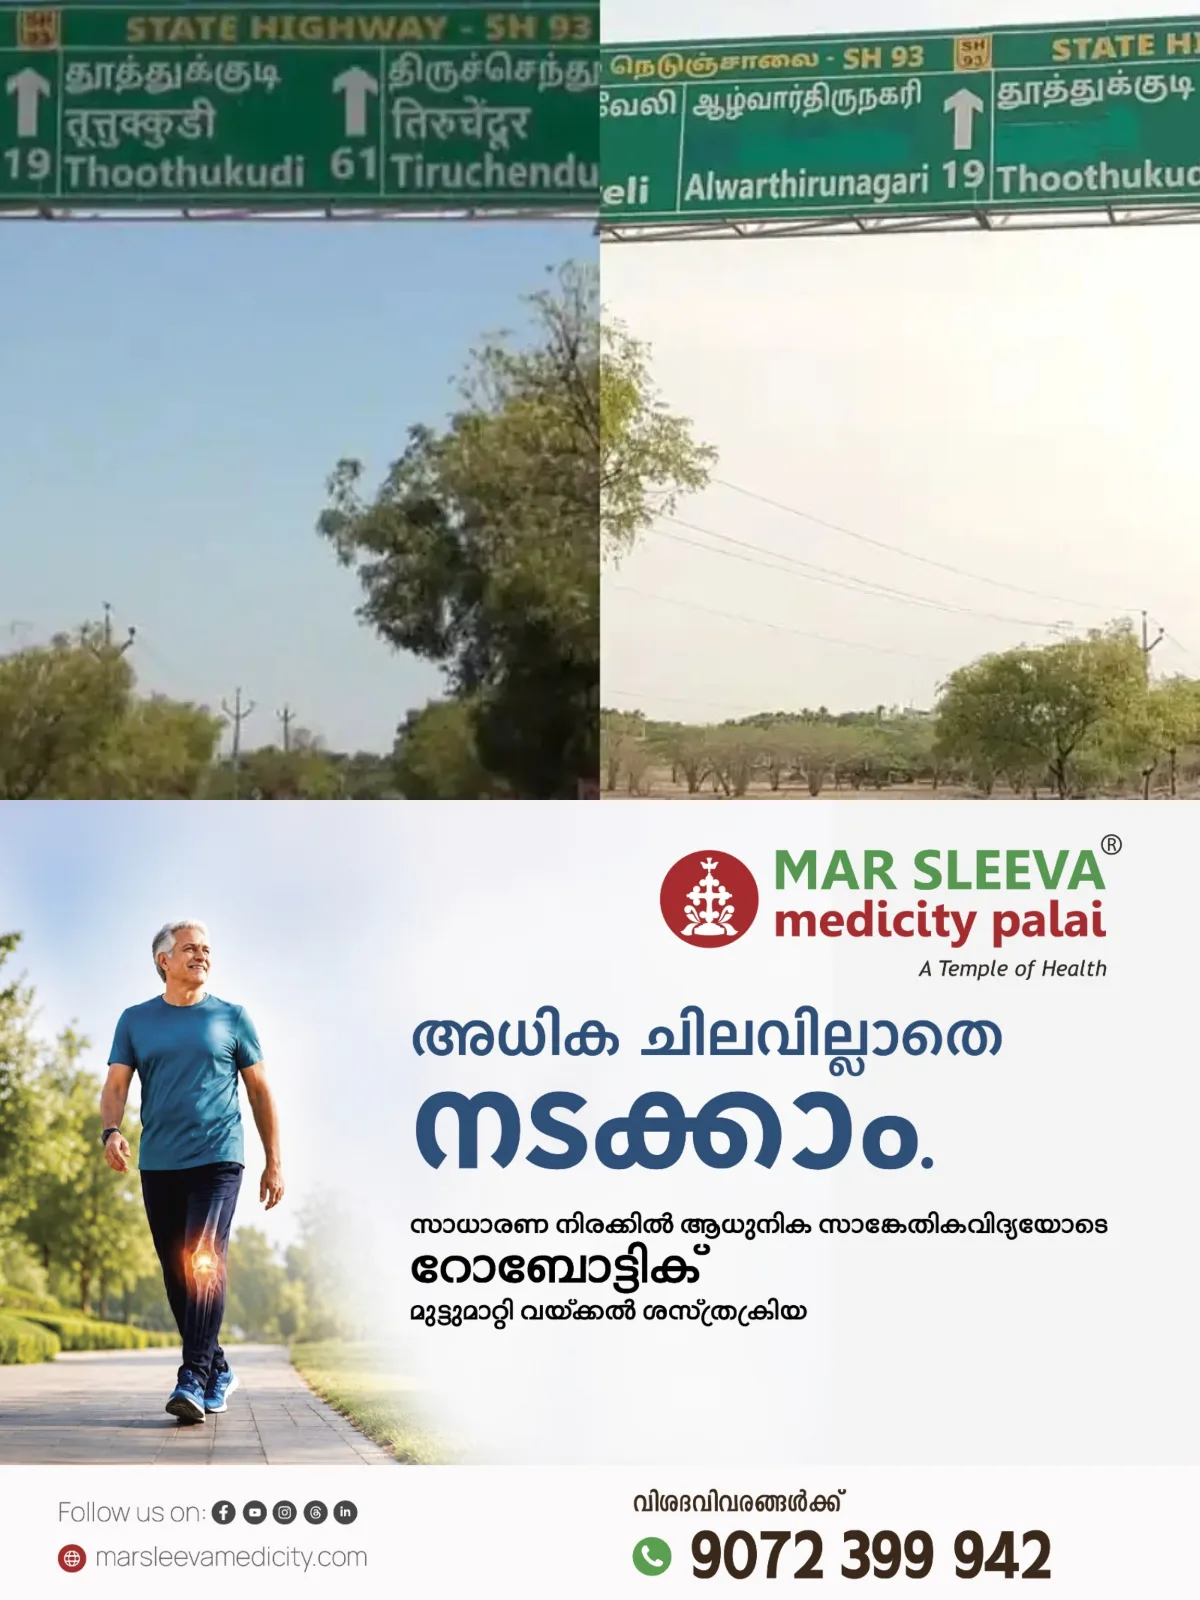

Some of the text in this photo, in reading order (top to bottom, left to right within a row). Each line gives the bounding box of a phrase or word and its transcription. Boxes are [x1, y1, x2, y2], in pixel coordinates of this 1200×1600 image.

[127, 15, 237, 43] STATE
[251, 15, 447, 42] HIGHWAY
[486, 14, 536, 42] SH
[550, 15, 592, 42] 93
[961, 39, 986, 51] SH
[610, 52, 820, 80] நெடுஞ்சாலை
[843, 47, 881, 69] SH
[891, 45, 924, 67] 93
[963, 54, 983, 65] 93
[1052, 33, 1155, 61] STATE
[65, 53, 281, 94] தூத்துக்குடி
[997, 68, 1196, 110] தூத்துக்குடி
[693, 77, 921, 121] ஆழ்வார்திருநகரி
[4, 147, 50, 180] 19
[63, 155, 305, 188] Thoothukudi
[330, 146, 376, 180] 61
[390, 152, 600, 188] Tiruchendu
[942, 159, 985, 188] 19
[600, 175, 650, 205] eli
[684, 163, 929, 203] Alwarthirunagari
[775, 849, 897, 890] MAR
[914, 848, 1106, 890] SLEEVA
[775, 899, 1107, 948] medicity palai
[918, 959, 1108, 982] A Temple of Health
[412, 1005, 1003, 1077] അധിക ചിലവില്ലാതെ
[415, 1090, 934, 1170] നടക്കാം.
[410, 1210, 1109, 1241] സാധാരണ നിരക്കിൽ ആധുനിക സാങ്കേതികവിദ്യയോടെ
[411, 1241, 711, 1294] റോബോട്ടിക്
[410, 1297, 808, 1330] മുട്ടുമാറ്റി വയ്ക്കൽ ശസ്ത്രക്രിയ
[59, 1501, 206, 1523] Follow us on:
[633, 1488, 847, 1513] വിശദവിവരങ്ങൾക്ക്
[96, 1545, 368, 1573] marsleevamedicity.com
[690, 1529, 1052, 1580] 9072 399 942
